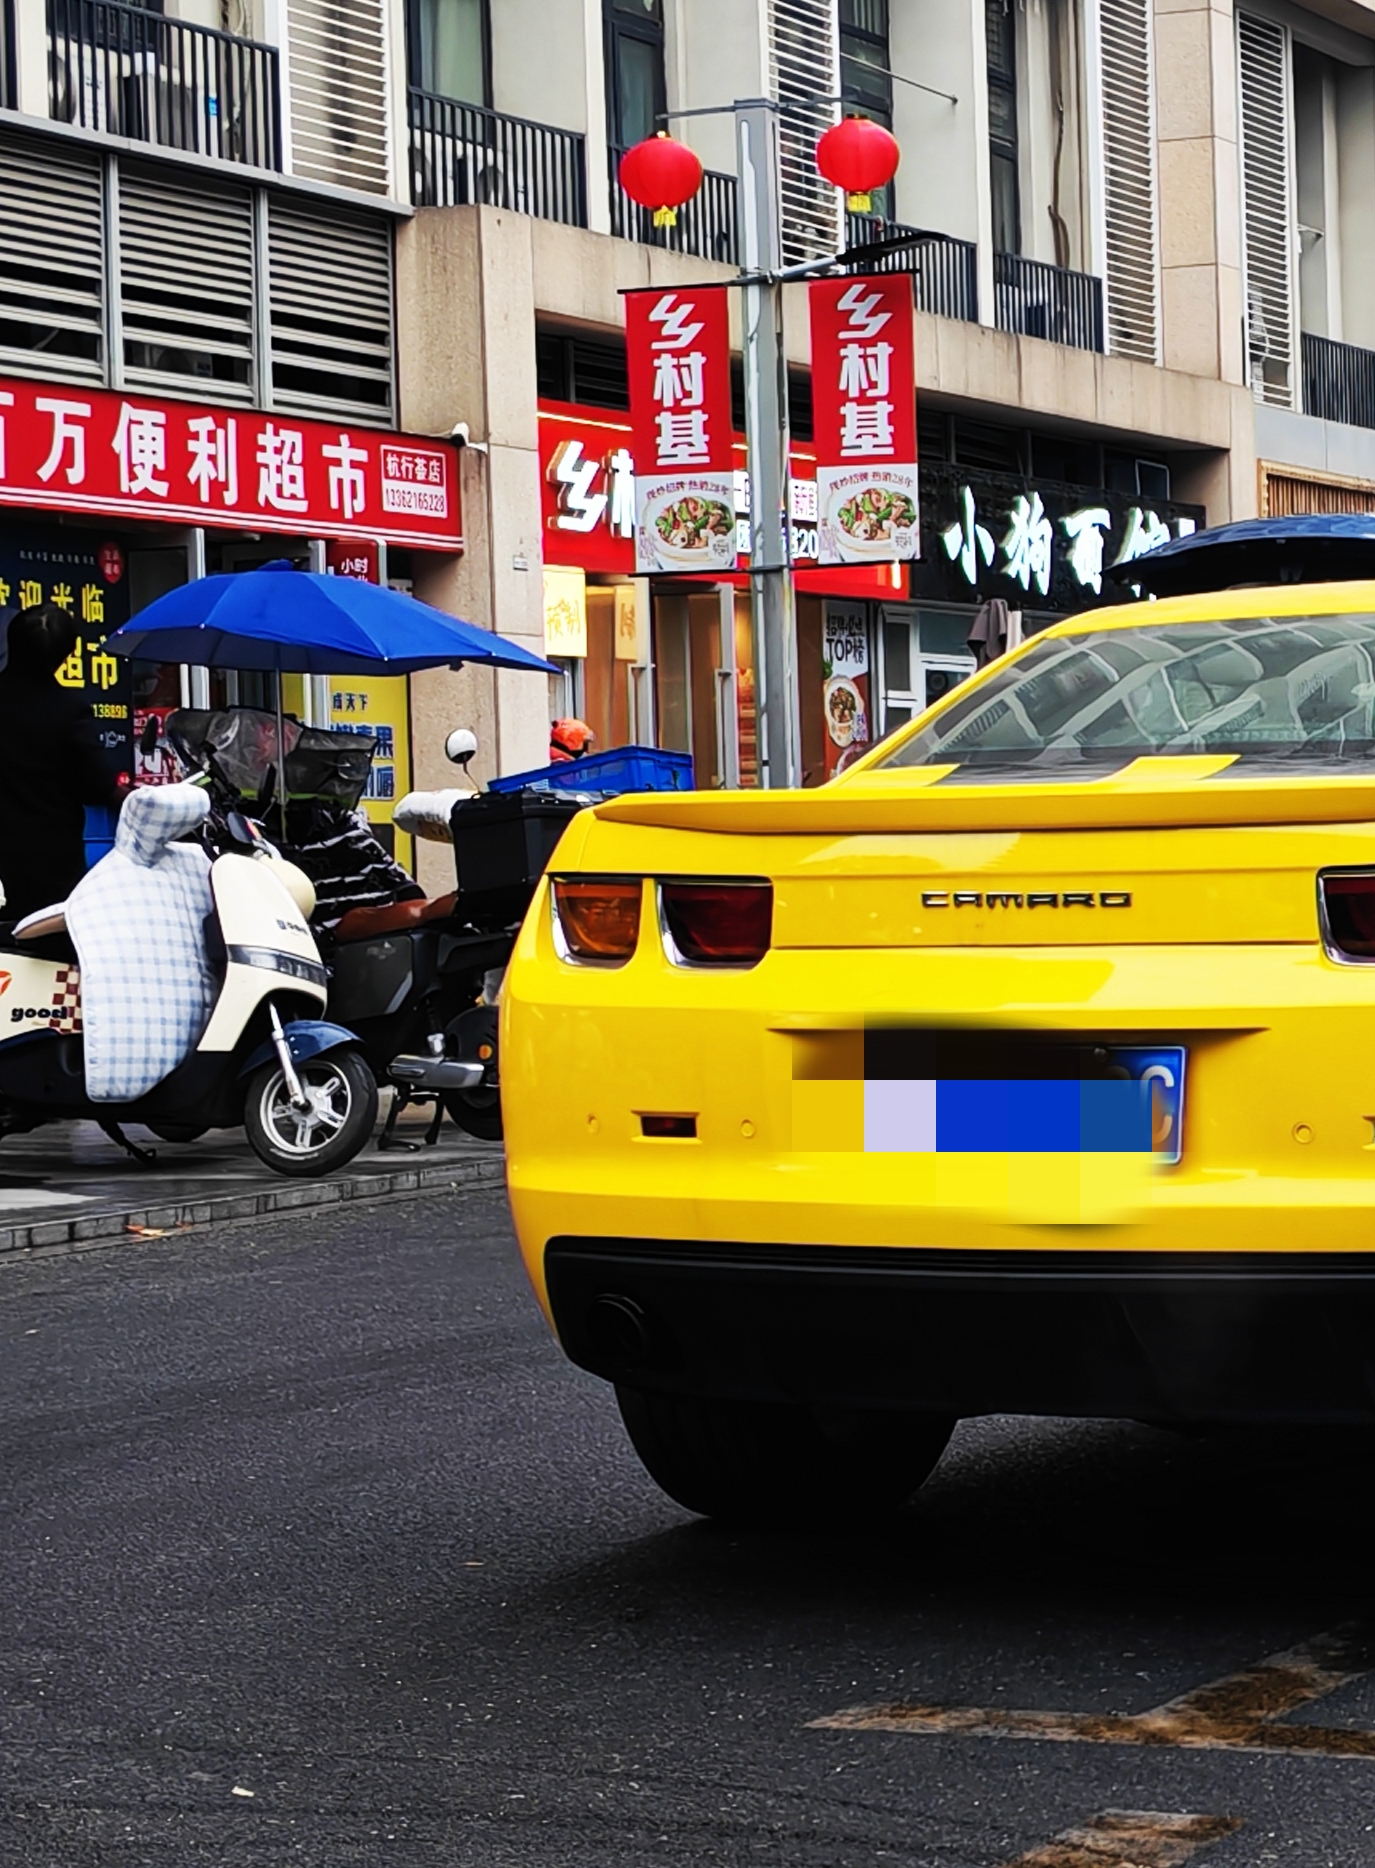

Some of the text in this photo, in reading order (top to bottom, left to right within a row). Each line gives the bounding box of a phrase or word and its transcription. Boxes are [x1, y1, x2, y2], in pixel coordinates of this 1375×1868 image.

[649, 294, 710, 467] 乡村基
[837, 284, 894, 457] 乡村基
[920, 891, 1133, 909] CAMARO
